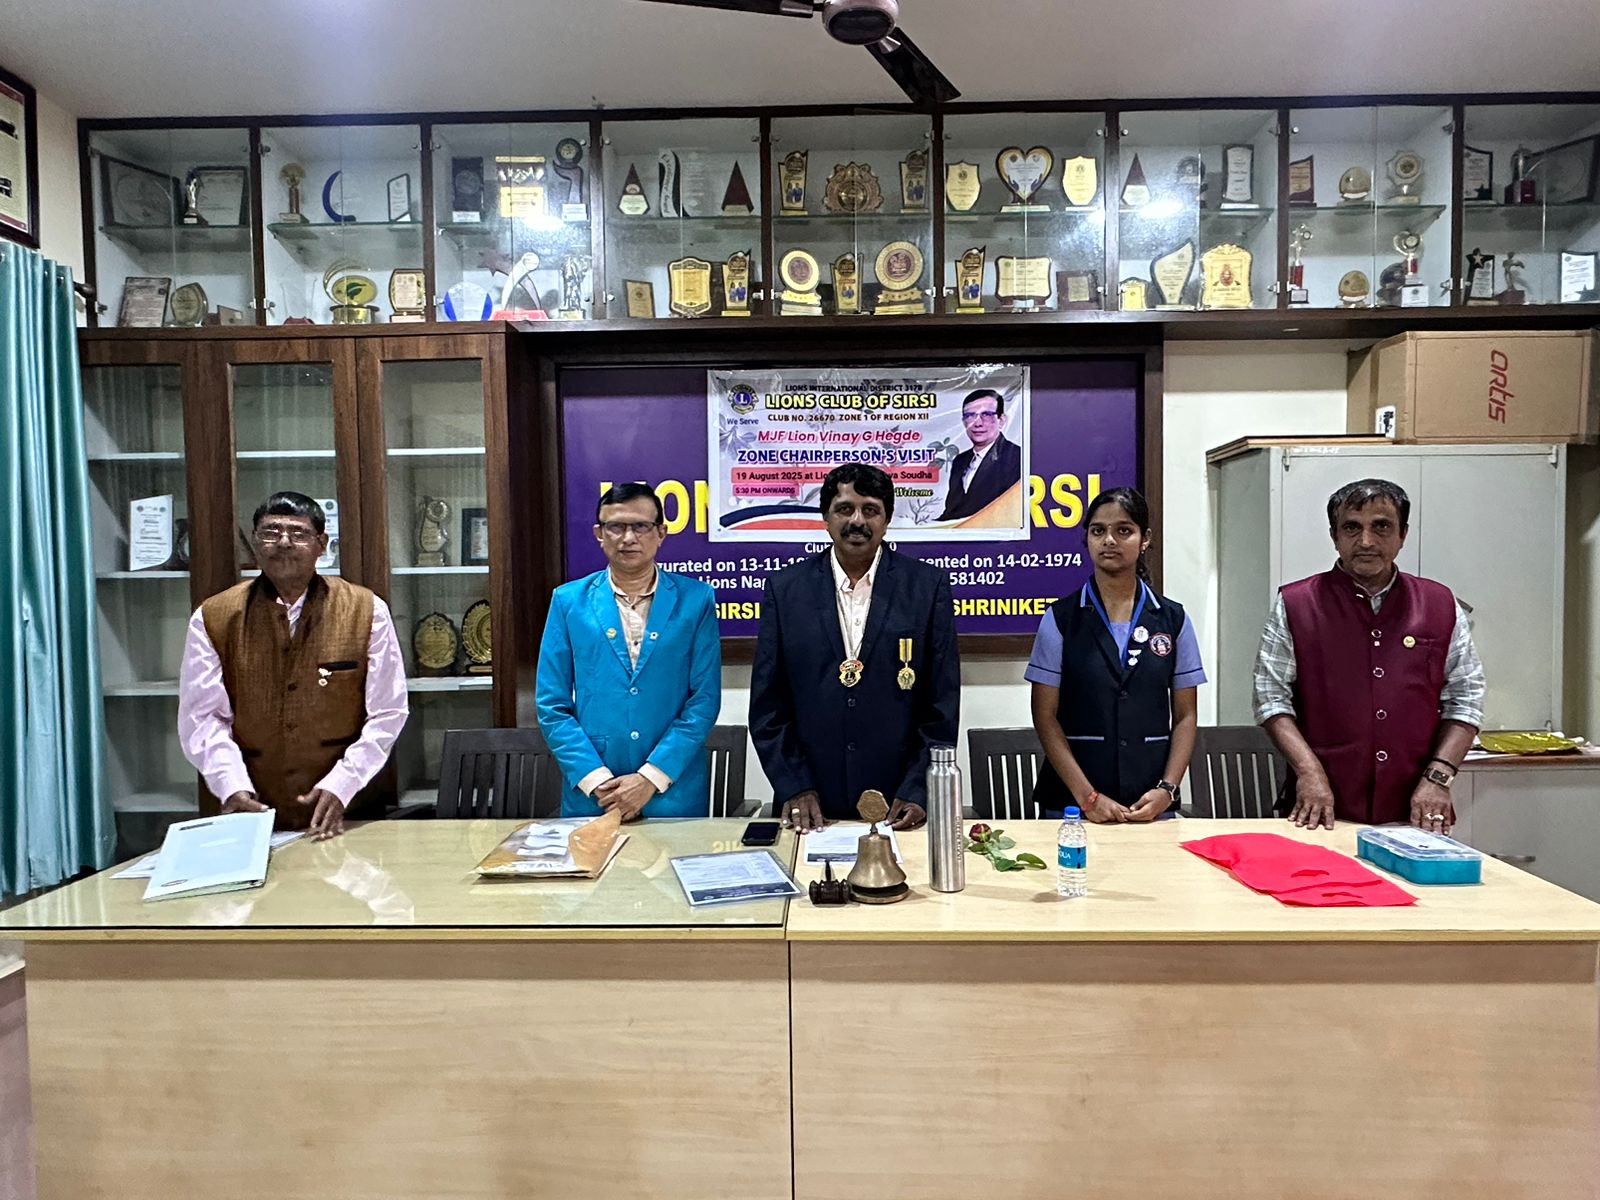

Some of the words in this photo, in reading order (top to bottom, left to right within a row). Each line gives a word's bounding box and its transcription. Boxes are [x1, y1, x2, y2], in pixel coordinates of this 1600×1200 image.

[785, 384, 807, 392] LIONS
[870, 384, 903, 392] DISTRICT
[1488, 349, 1515, 424] artis
[765, 393, 815, 410] LIONS
[818, 393, 864, 410] CLUB
[866, 393, 890, 409] OF
[892, 392, 937, 409] SIRSI
[768, 414, 789, 422] CLUB
[791, 414, 807, 422] NO.
[809, 414, 835, 422] 26670
[870, 413, 882, 421] OF
[884, 413, 916, 421] REGION
[758, 431, 786, 442] MJF
[788, 431, 816, 442] Lion
[818, 430, 859, 447] Vinay
[862, 431, 872, 442] G
[875, 430, 920, 446] Hegde
[737, 450, 776, 463] ZONE
[779, 449, 895, 464] CHAIRPERSON'S
[899, 448, 936, 462] VISIT
[736, 472, 747, 480] 19
[749, 472, 779, 482] August
[781, 472, 802, 480] 2025
[804, 472, 813, 480] at
[815, 472, 828, 480] Lio
[900, 471, 932, 479] Soudha
[716, 561, 735, 572] on
[972, 557, 993, 568] on
[996, 553, 1082, 568] 14-02-1974
